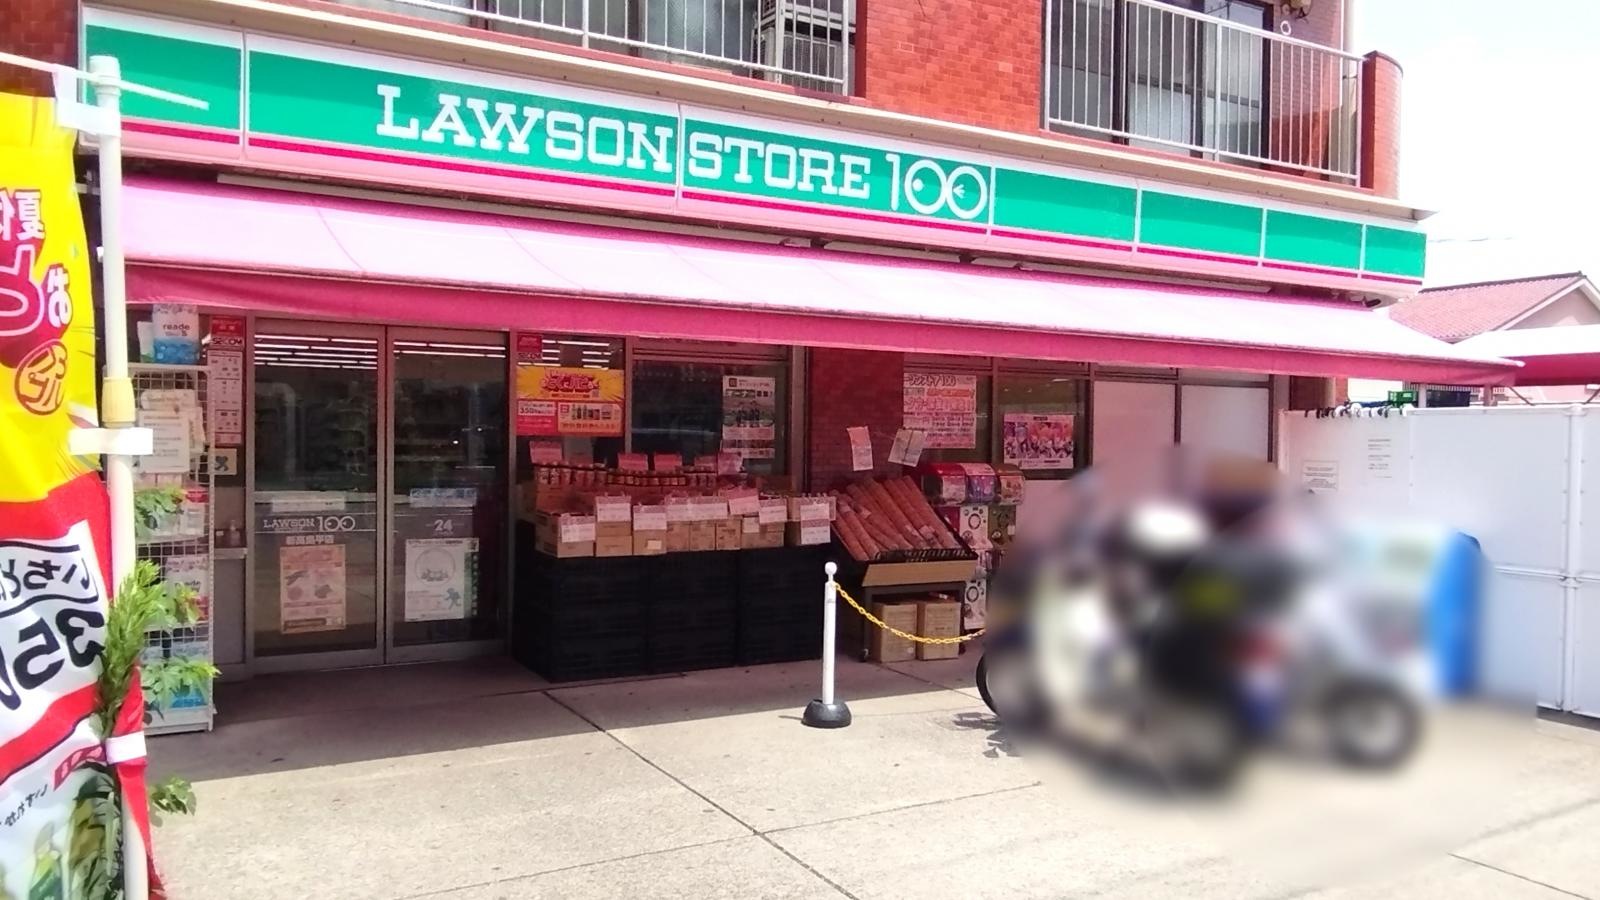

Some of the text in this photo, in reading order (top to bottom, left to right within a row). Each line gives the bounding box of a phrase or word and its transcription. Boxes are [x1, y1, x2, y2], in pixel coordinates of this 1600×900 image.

[376, 83, 988, 220] LAWSON STORE 100
[263, 516, 356, 531] LAWSON 100
[434, 519, 453, 531] 24
